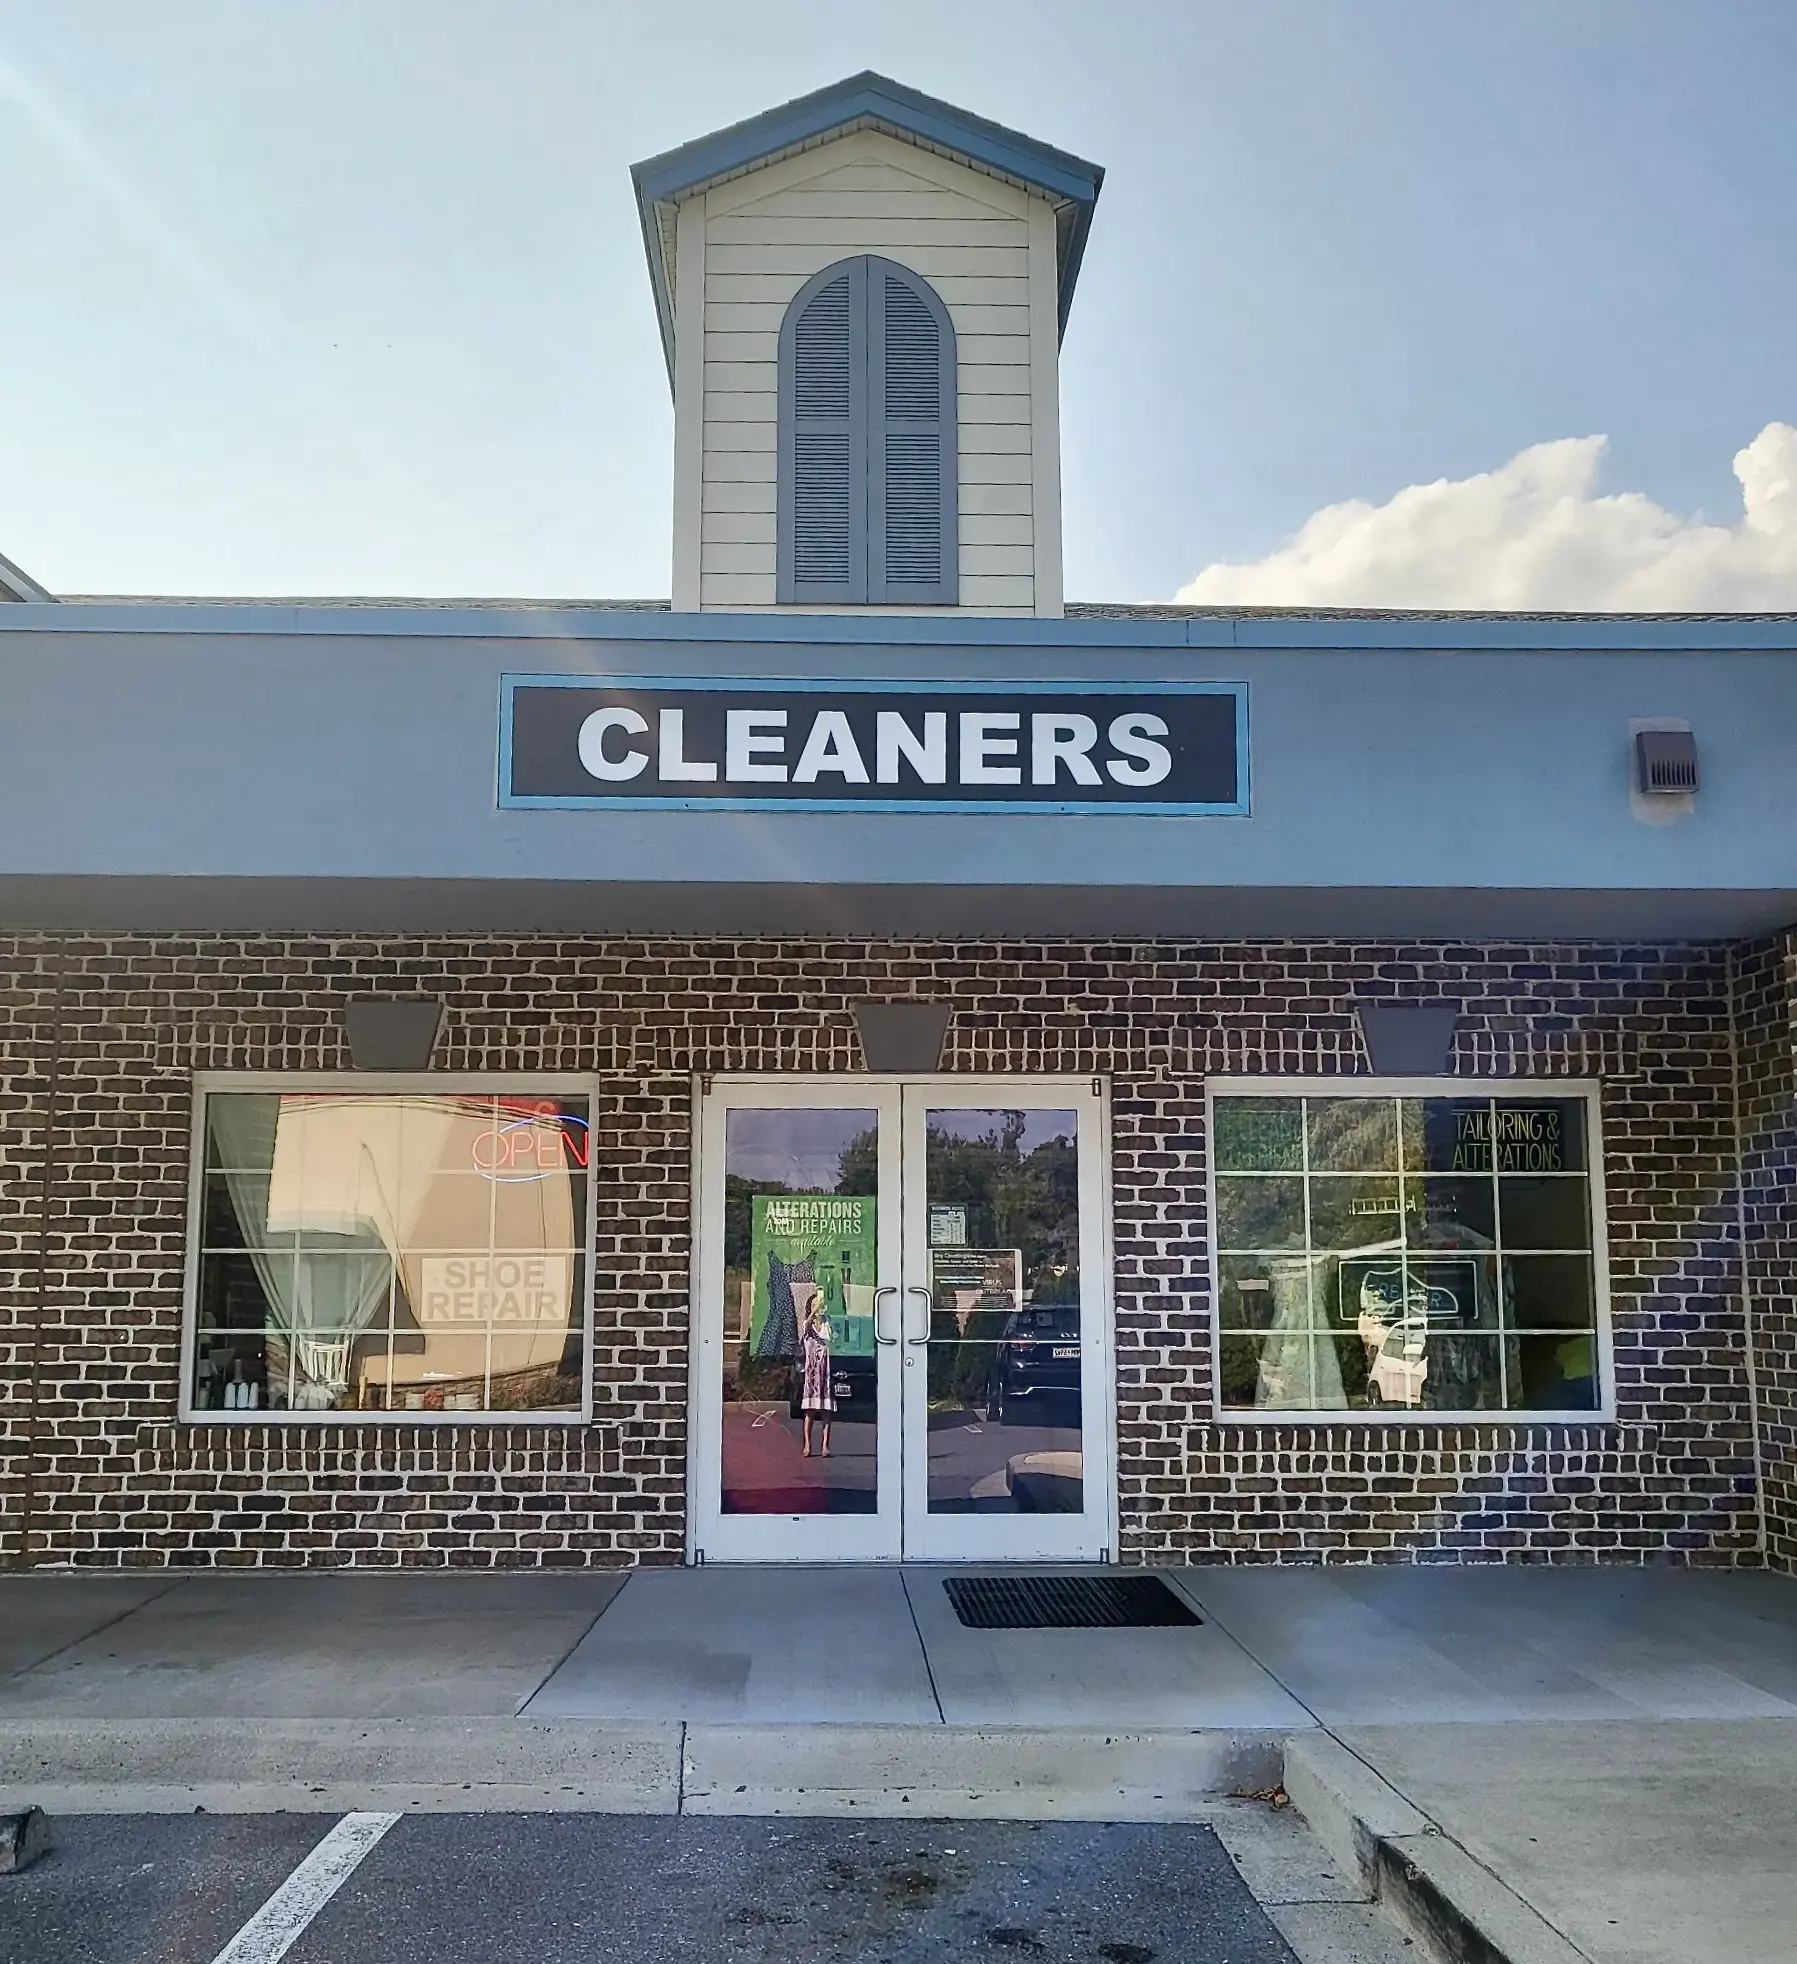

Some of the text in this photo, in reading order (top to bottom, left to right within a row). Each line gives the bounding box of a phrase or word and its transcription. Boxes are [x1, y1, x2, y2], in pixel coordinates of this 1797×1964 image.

[577, 707, 1173, 787] CLEANERS
[1451, 1112, 1560, 1140] TAILORING &
[472, 1131, 589, 1167] OPEN
[1452, 1143, 1562, 1171] ALTERATIONS
[765, 1201, 862, 1218] ALTERATIONS
[765, 1219, 862, 1234] AND REPAIRS
[444, 1260, 546, 1289] SHOE
[427, 1291, 559, 1320] REPAIR
